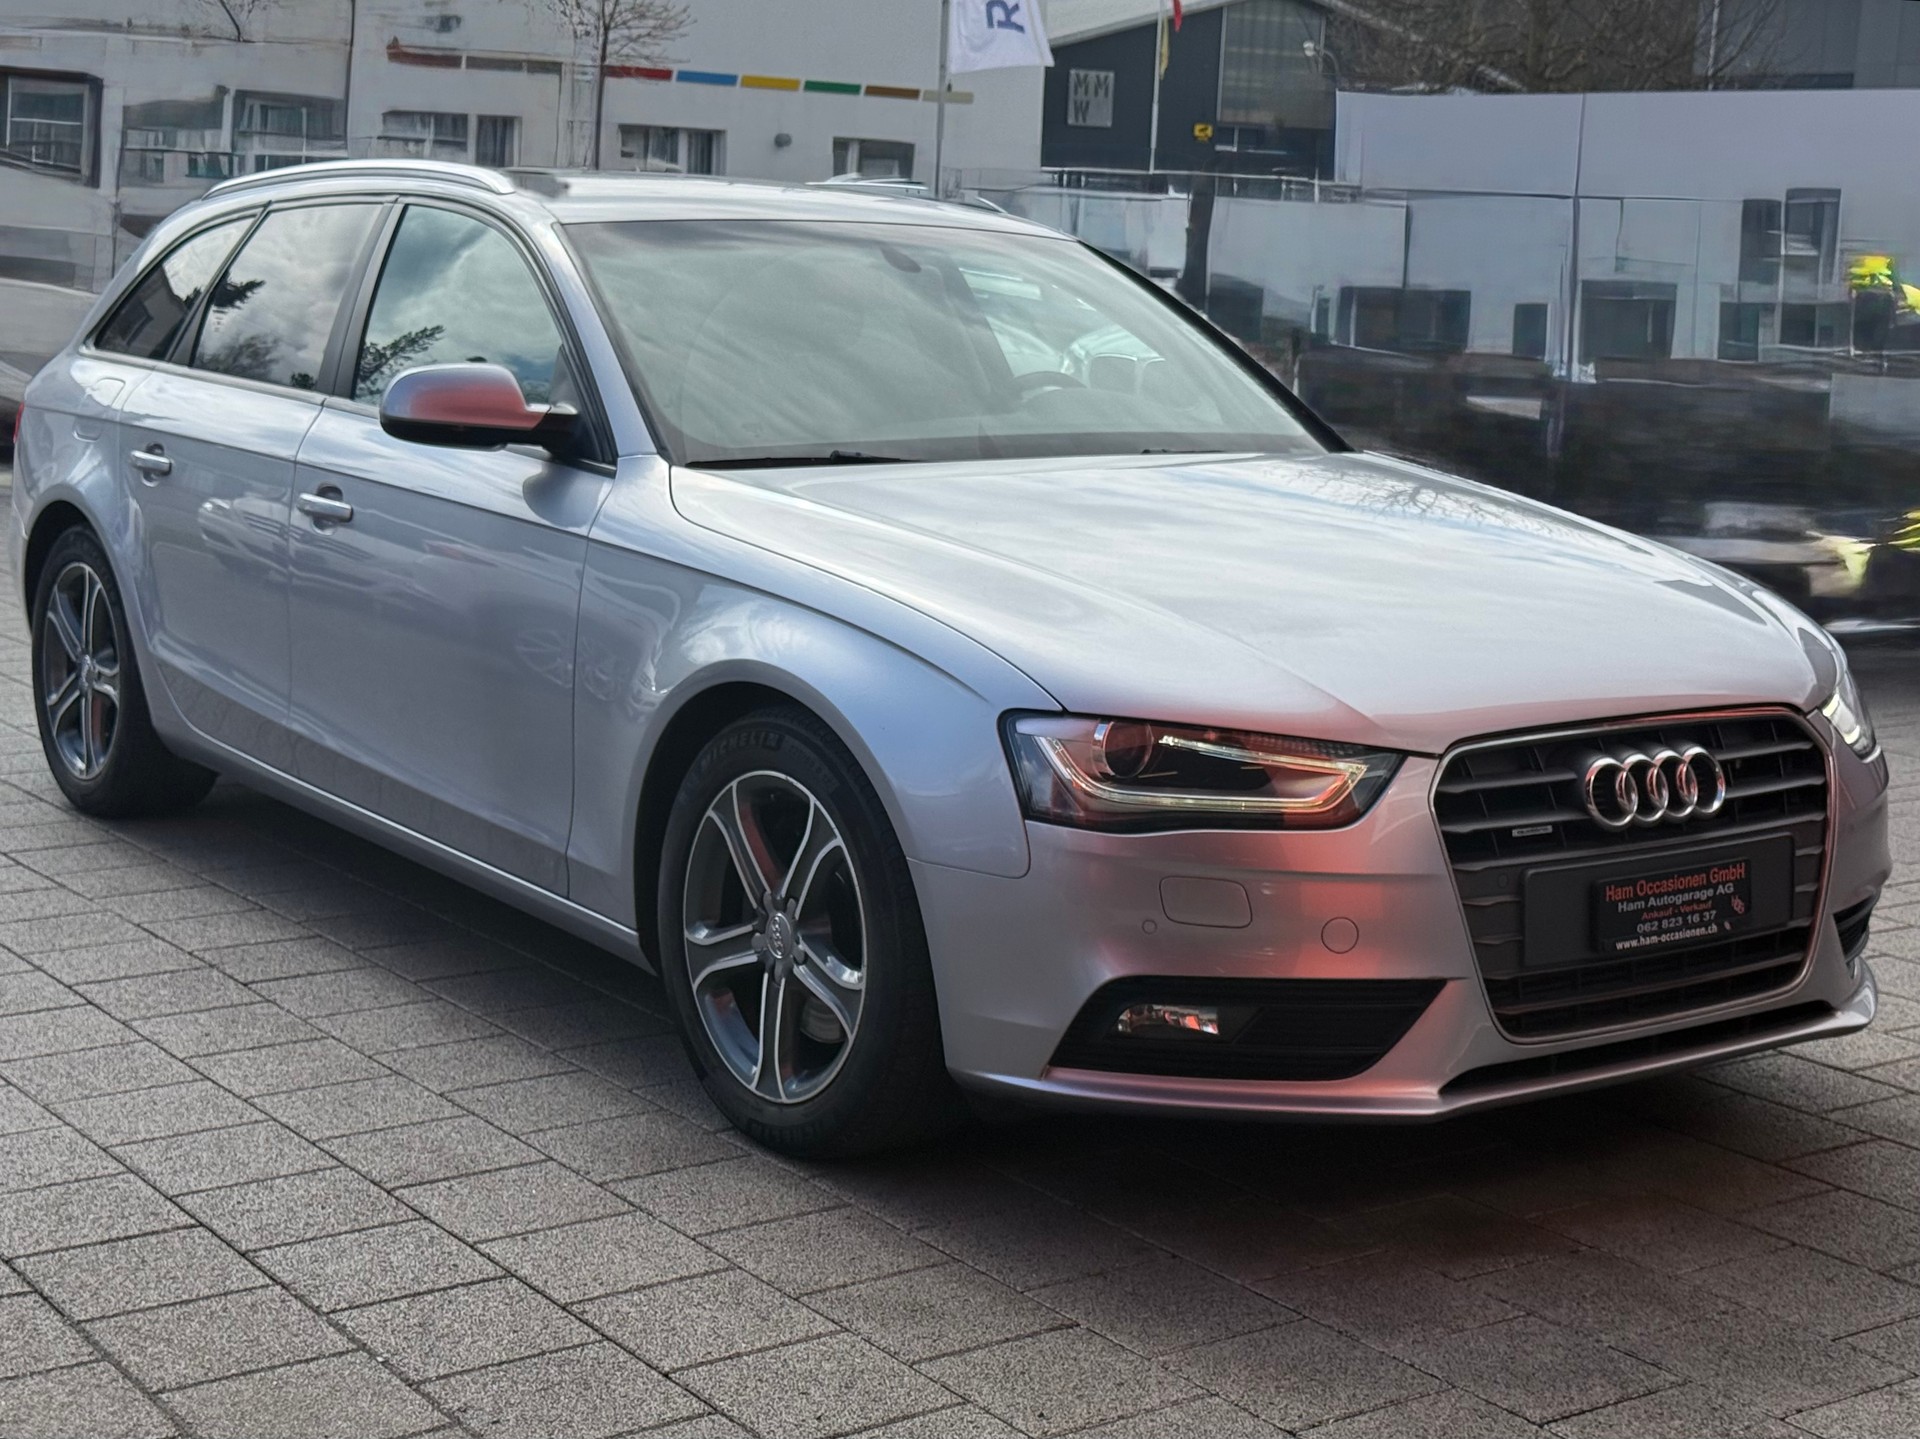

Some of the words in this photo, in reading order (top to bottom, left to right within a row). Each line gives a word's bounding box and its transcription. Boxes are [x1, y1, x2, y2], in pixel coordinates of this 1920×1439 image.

[1605, 884, 1634, 902] Ham
[1636, 873, 1706, 896] Occasionen
[1710, 863, 1745, 884] GmbH
[1617, 900, 1645, 913] Ham
[1648, 888, 1714, 907] Autogarage
[1716, 882, 1735, 896] AG
[1641, 908, 1674, 921] Ankauf
[1680, 900, 1713, 913] Verkauf
[1636, 919, 1659, 933] 062
[1661, 916, 1683, 929] 823
[1686, 913, 1701, 924] 16
[1703, 910, 1717, 921] 37
[1615, 924, 1718, 950] www.ham-occasionen.ch
